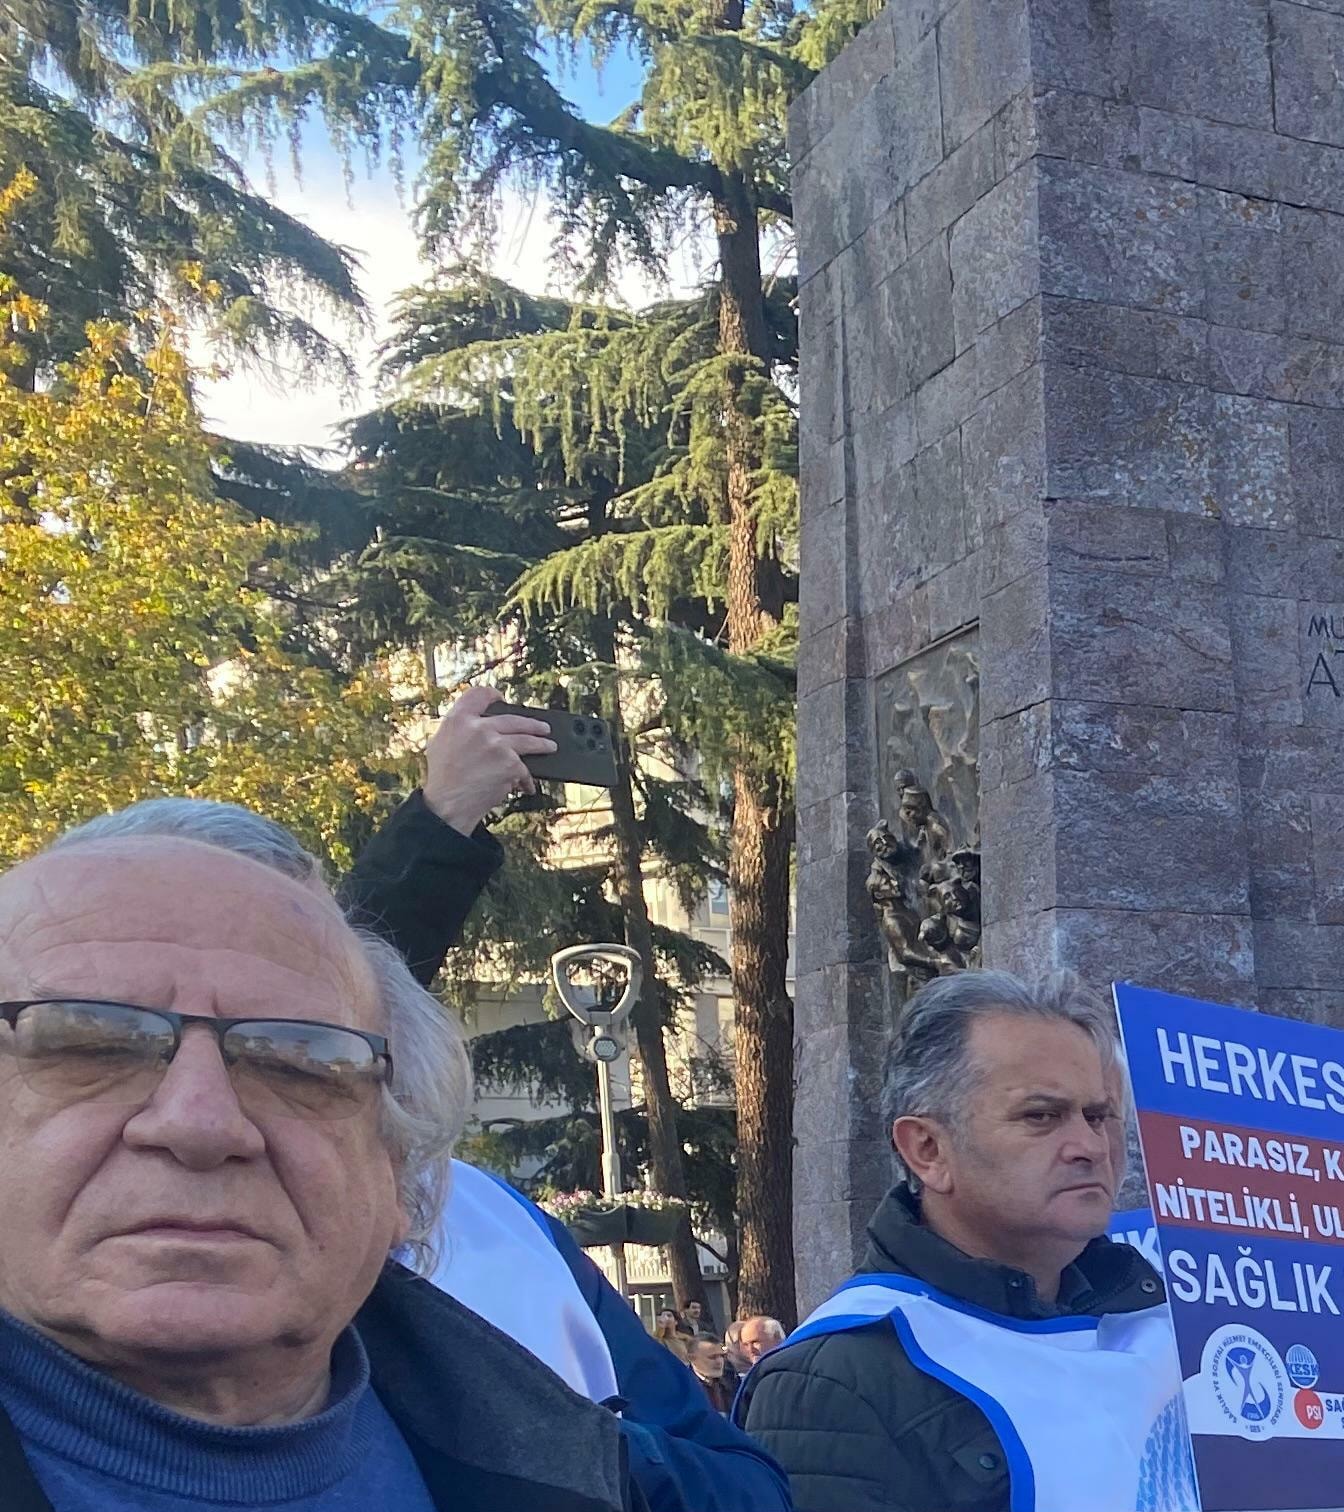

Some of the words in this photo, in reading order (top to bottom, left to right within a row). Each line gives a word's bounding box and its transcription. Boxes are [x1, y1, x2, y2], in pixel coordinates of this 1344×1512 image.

[1179, 1125, 1320, 1182] PARASIZ,
[1156, 1178, 1310, 1239] NİTELİKLİ,
[1168, 1246, 1340, 1316] SAĞLIK
